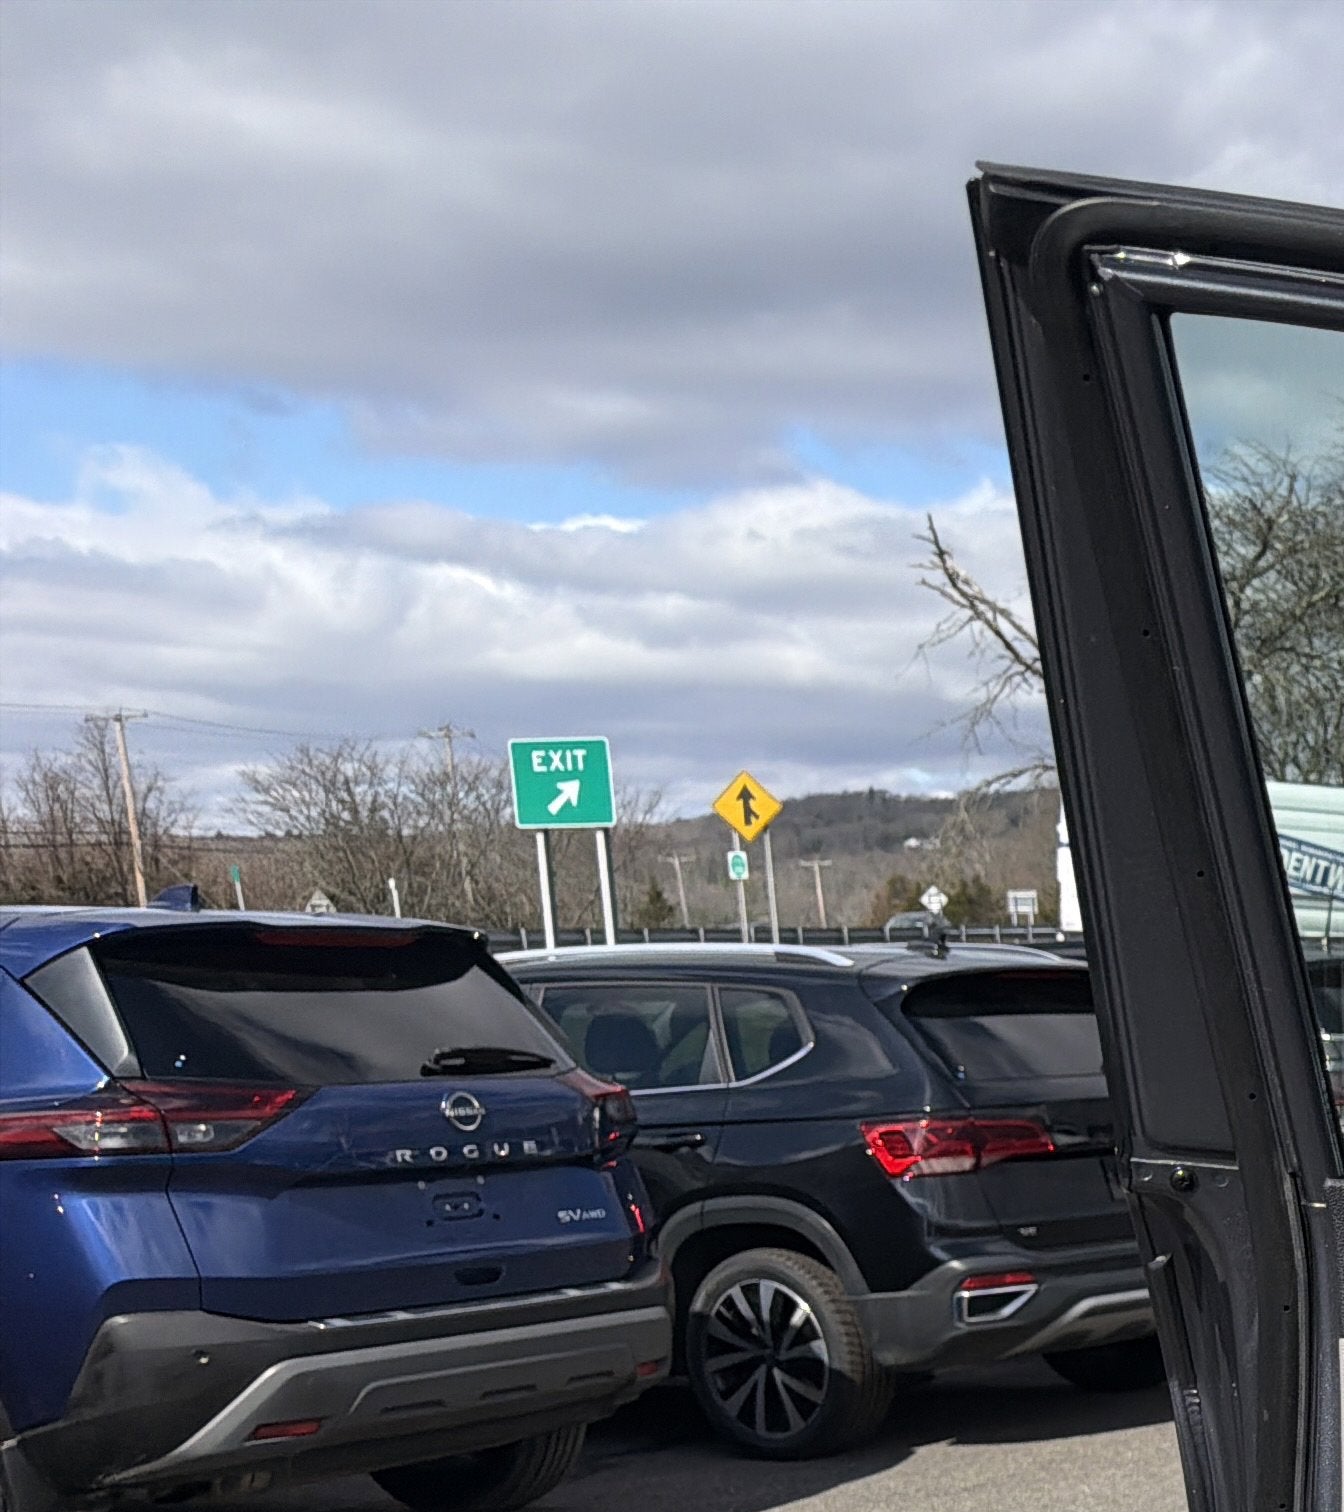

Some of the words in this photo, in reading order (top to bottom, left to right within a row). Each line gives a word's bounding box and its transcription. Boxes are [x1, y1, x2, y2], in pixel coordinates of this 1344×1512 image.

[531, 748, 587, 772] EXIT
[395, 1139, 538, 1163] ROGUE
[557, 1208, 581, 1223] SV
